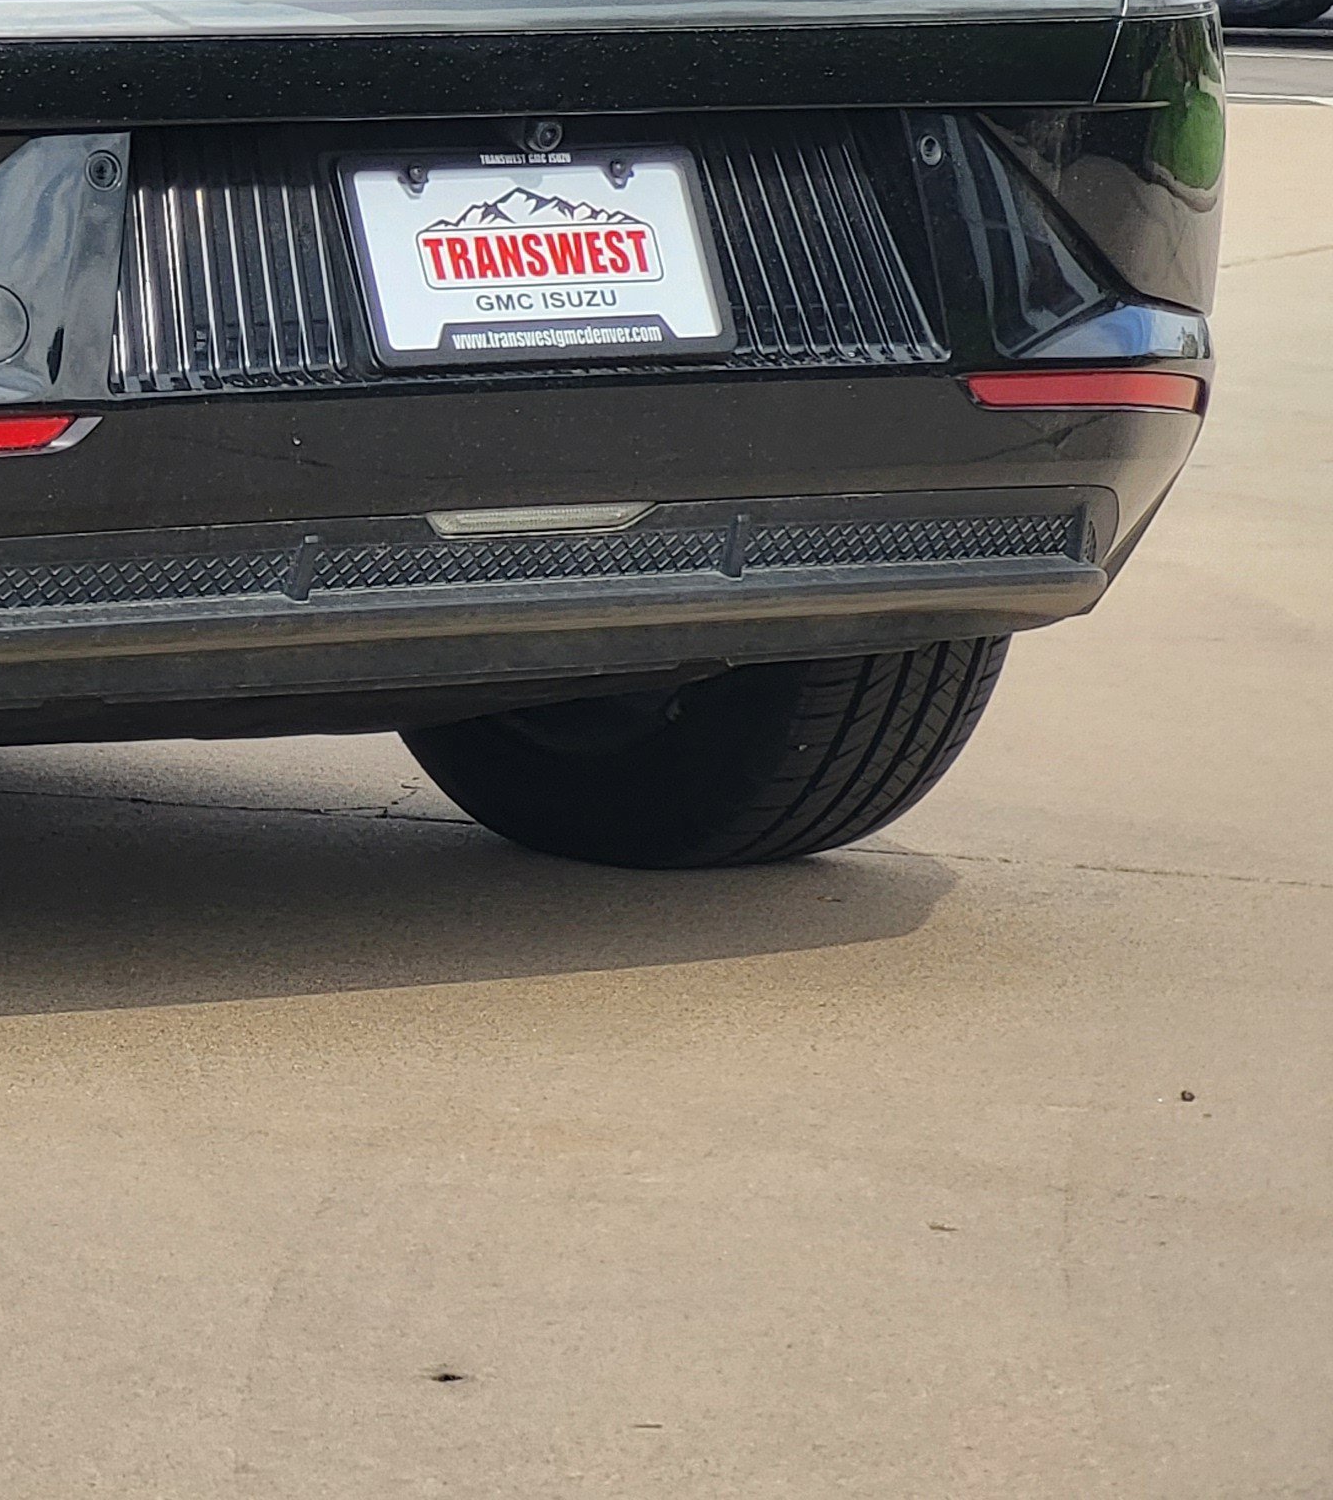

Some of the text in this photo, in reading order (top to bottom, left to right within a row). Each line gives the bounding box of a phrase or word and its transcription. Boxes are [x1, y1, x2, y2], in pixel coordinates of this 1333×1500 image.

[480, 154, 527, 165] TRANSWEST
[548, 152, 571, 164] ISUZU
[422, 230, 649, 281] TRANSWEST
[476, 289, 618, 312] GMC ISUZU
[451, 325, 663, 350] www.transwestgmcdenver.com
